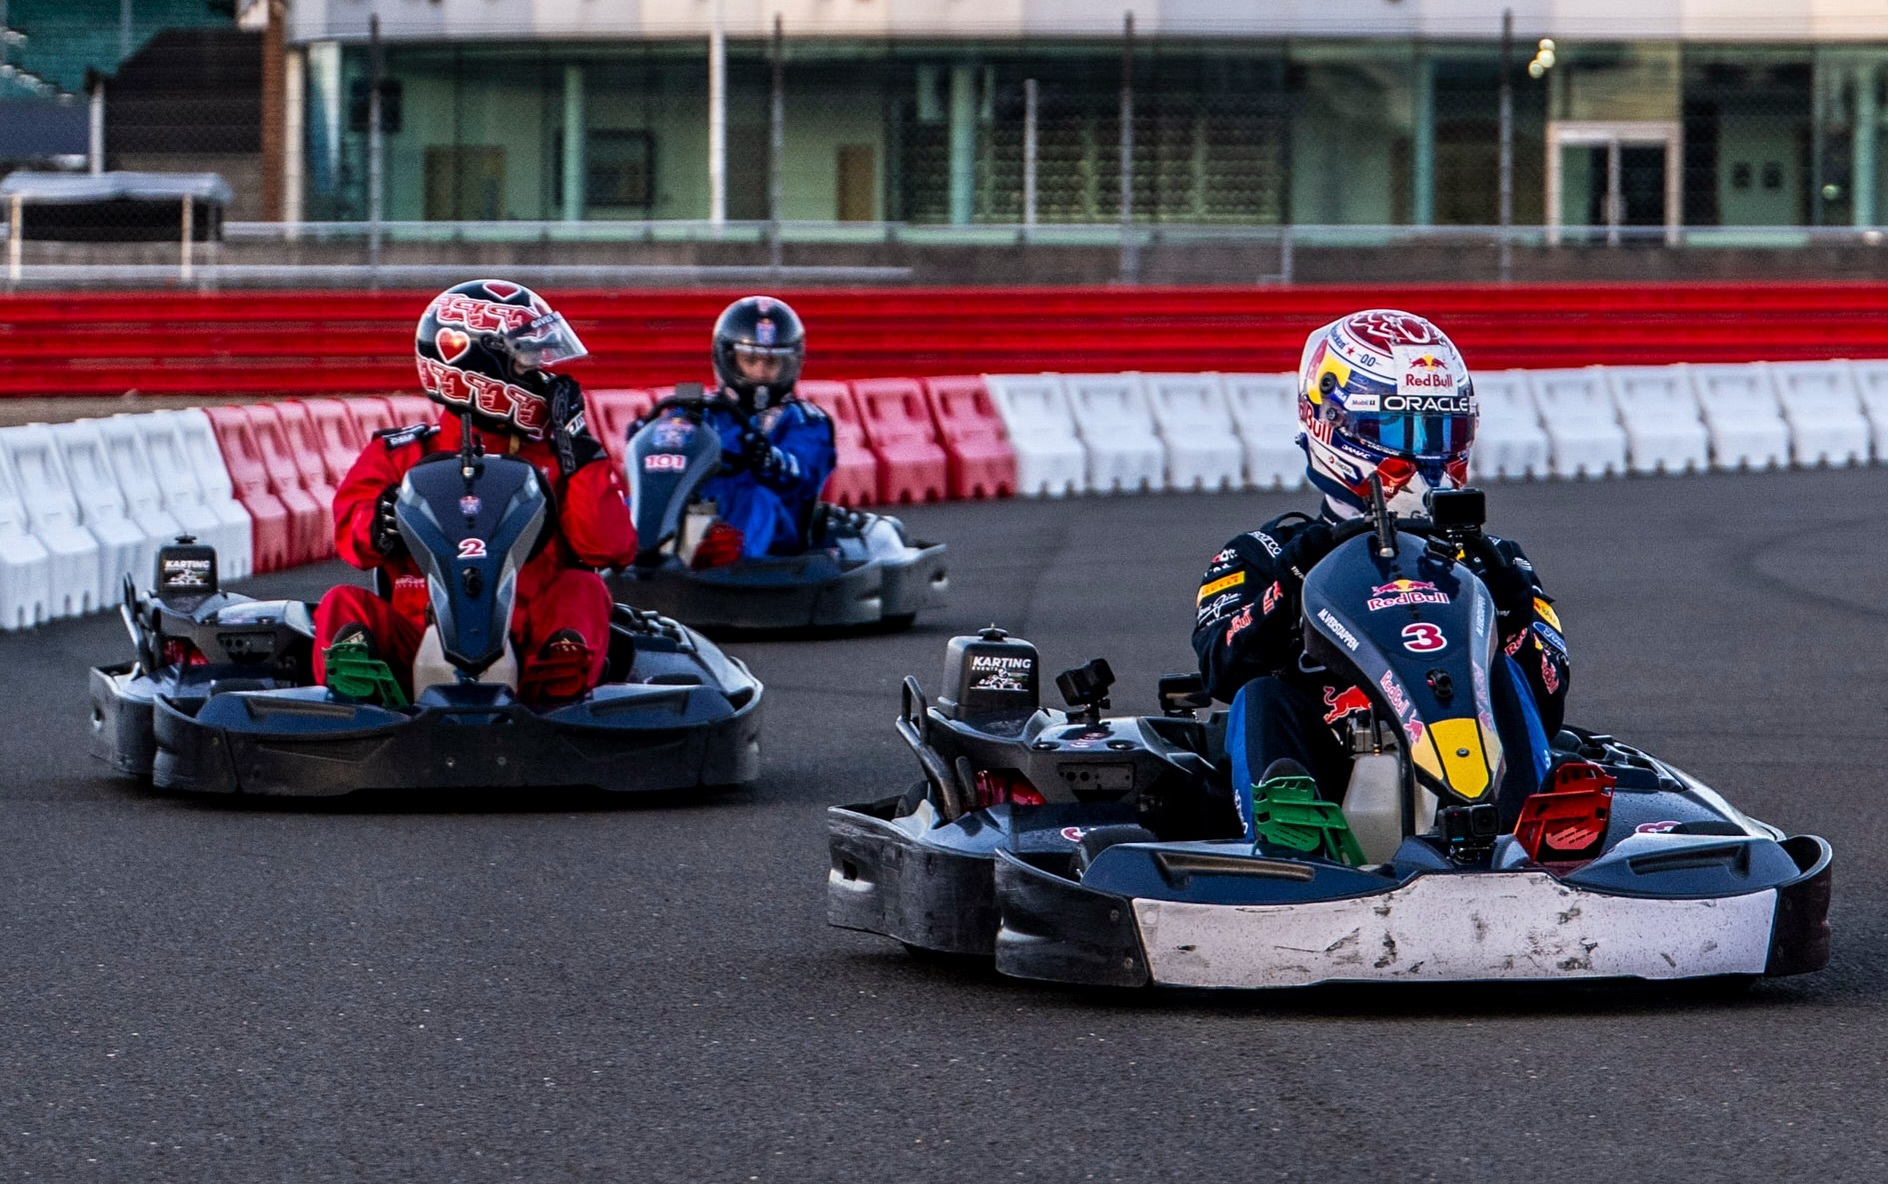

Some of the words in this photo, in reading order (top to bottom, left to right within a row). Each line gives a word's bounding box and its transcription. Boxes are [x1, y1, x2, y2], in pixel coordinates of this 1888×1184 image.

[1405, 374, 1431, 387] Red
[1433, 374, 1453, 387] Bull
[1384, 396, 1468, 411] ORACLE
[457, 538, 487, 559] 2
[1367, 593, 1410, 611] Red
[1409, 592, 1450, 604] Bull
[1401, 623, 1447, 652] 3
[973, 656, 1032, 668] KARTING
